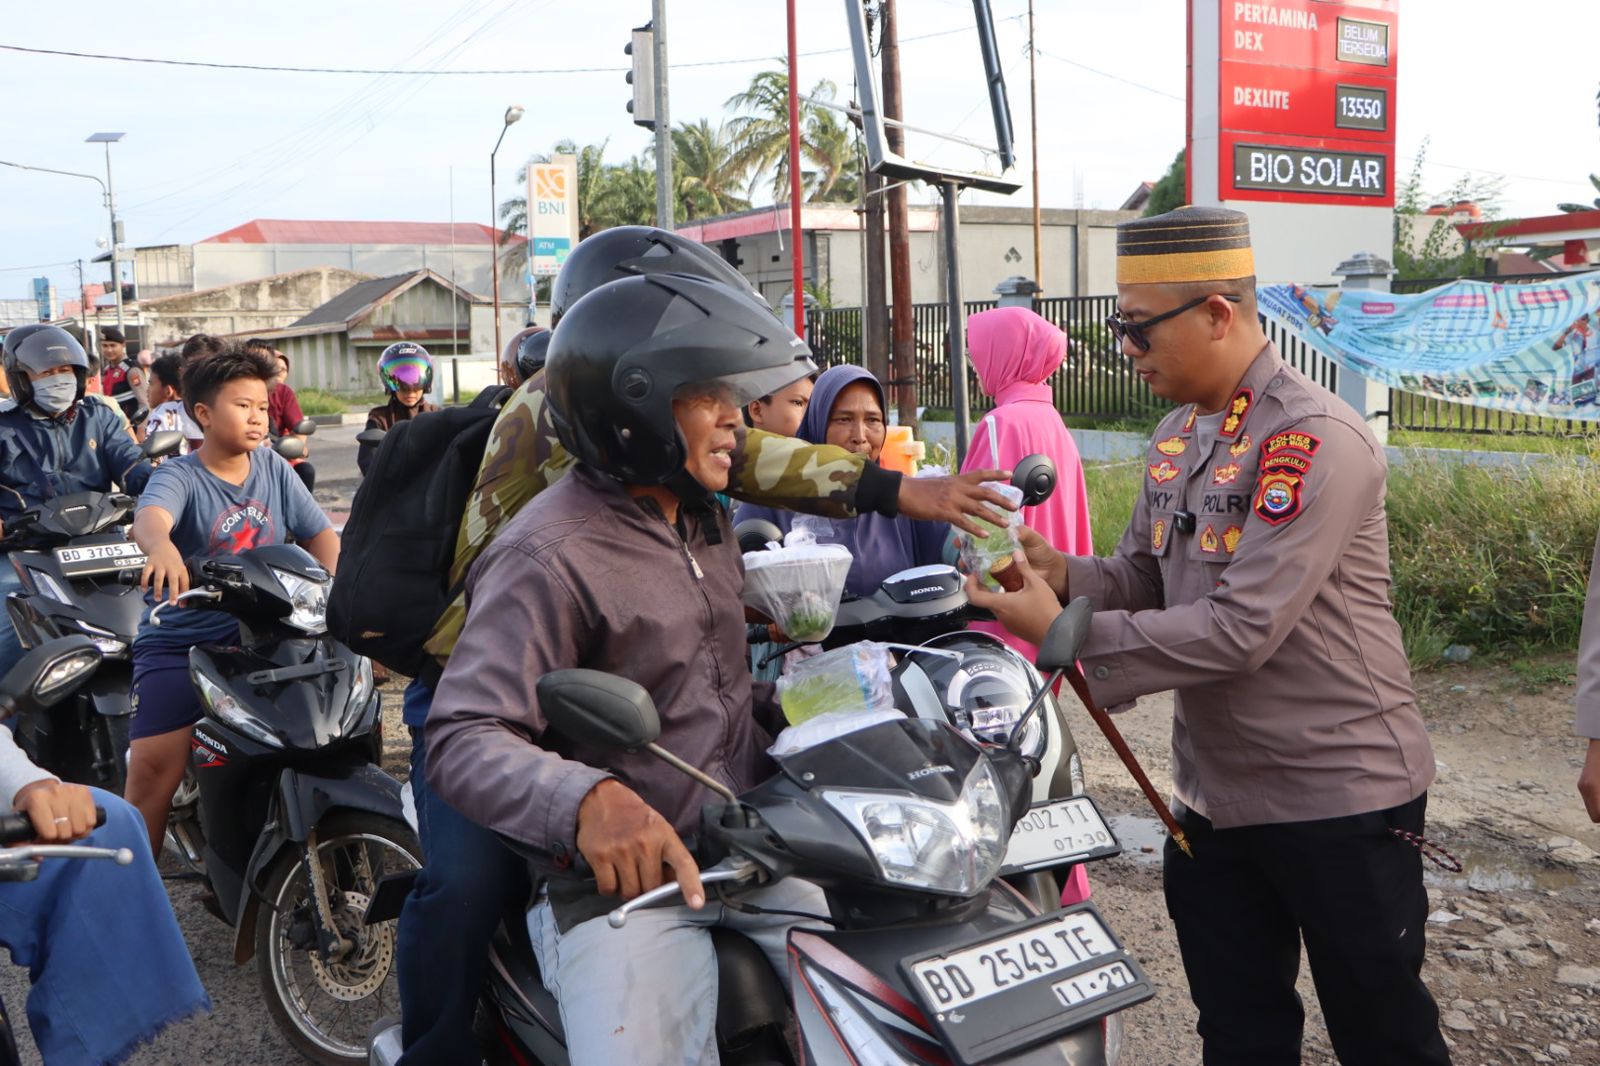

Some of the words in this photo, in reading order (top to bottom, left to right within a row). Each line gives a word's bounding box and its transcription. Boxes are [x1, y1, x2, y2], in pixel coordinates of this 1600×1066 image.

[1234, 2, 1318, 31] PERTAMINA
[1234, 30, 1264, 52] DEX
[1344, 25, 1378, 42] BELUM
[1340, 40, 1387, 58] TERSEDIA
[1234, 86, 1290, 110] DEXLITE
[1340, 96, 1381, 120] 13550
[1250, 152, 1294, 184] BIO
[1300, 156, 1380, 189] SOLAR
[538, 201, 565, 215] BNI
[1270, 433, 1311, 447] POLRES
[1264, 456, 1306, 469] BENGKULU
[1152, 491, 1173, 509] KY
[222, 506, 268, 533] CONVERSE
[62, 551, 80, 562] BD
[87, 546, 123, 559] 3705
[911, 586, 944, 596] HONDA
[195, 728, 229, 754] HONDA
[907, 765, 955, 780] HONDA
[1060, 805, 1089, 824] TI
[923, 964, 975, 1004] BD
[980, 938, 1058, 987] 2549
[1055, 927, 1104, 961] TE
